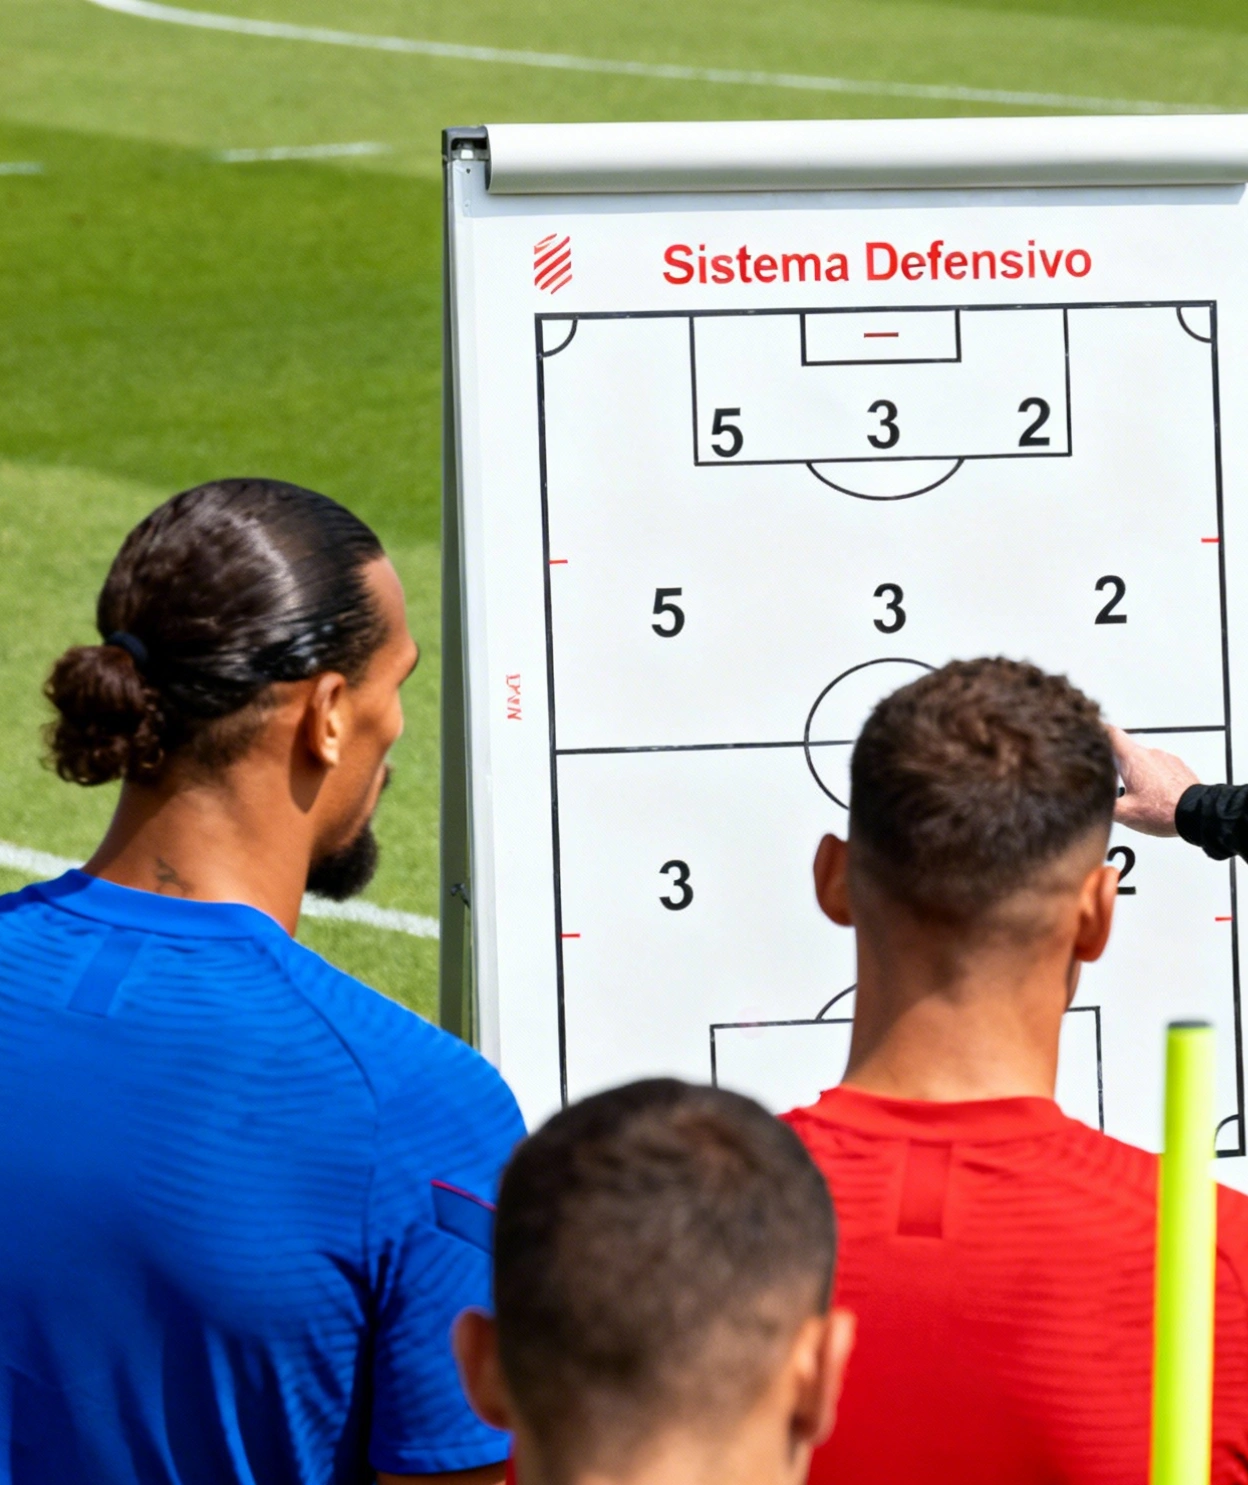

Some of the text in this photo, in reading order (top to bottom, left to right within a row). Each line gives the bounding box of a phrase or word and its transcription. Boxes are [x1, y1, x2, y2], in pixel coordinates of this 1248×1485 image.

[663, 238, 1092, 286] Sistema Defensivo
[710, 397, 1051, 457] 5 3 2
[651, 575, 1127, 638] 5 3 2
[659, 845, 1136, 911] 3 2
